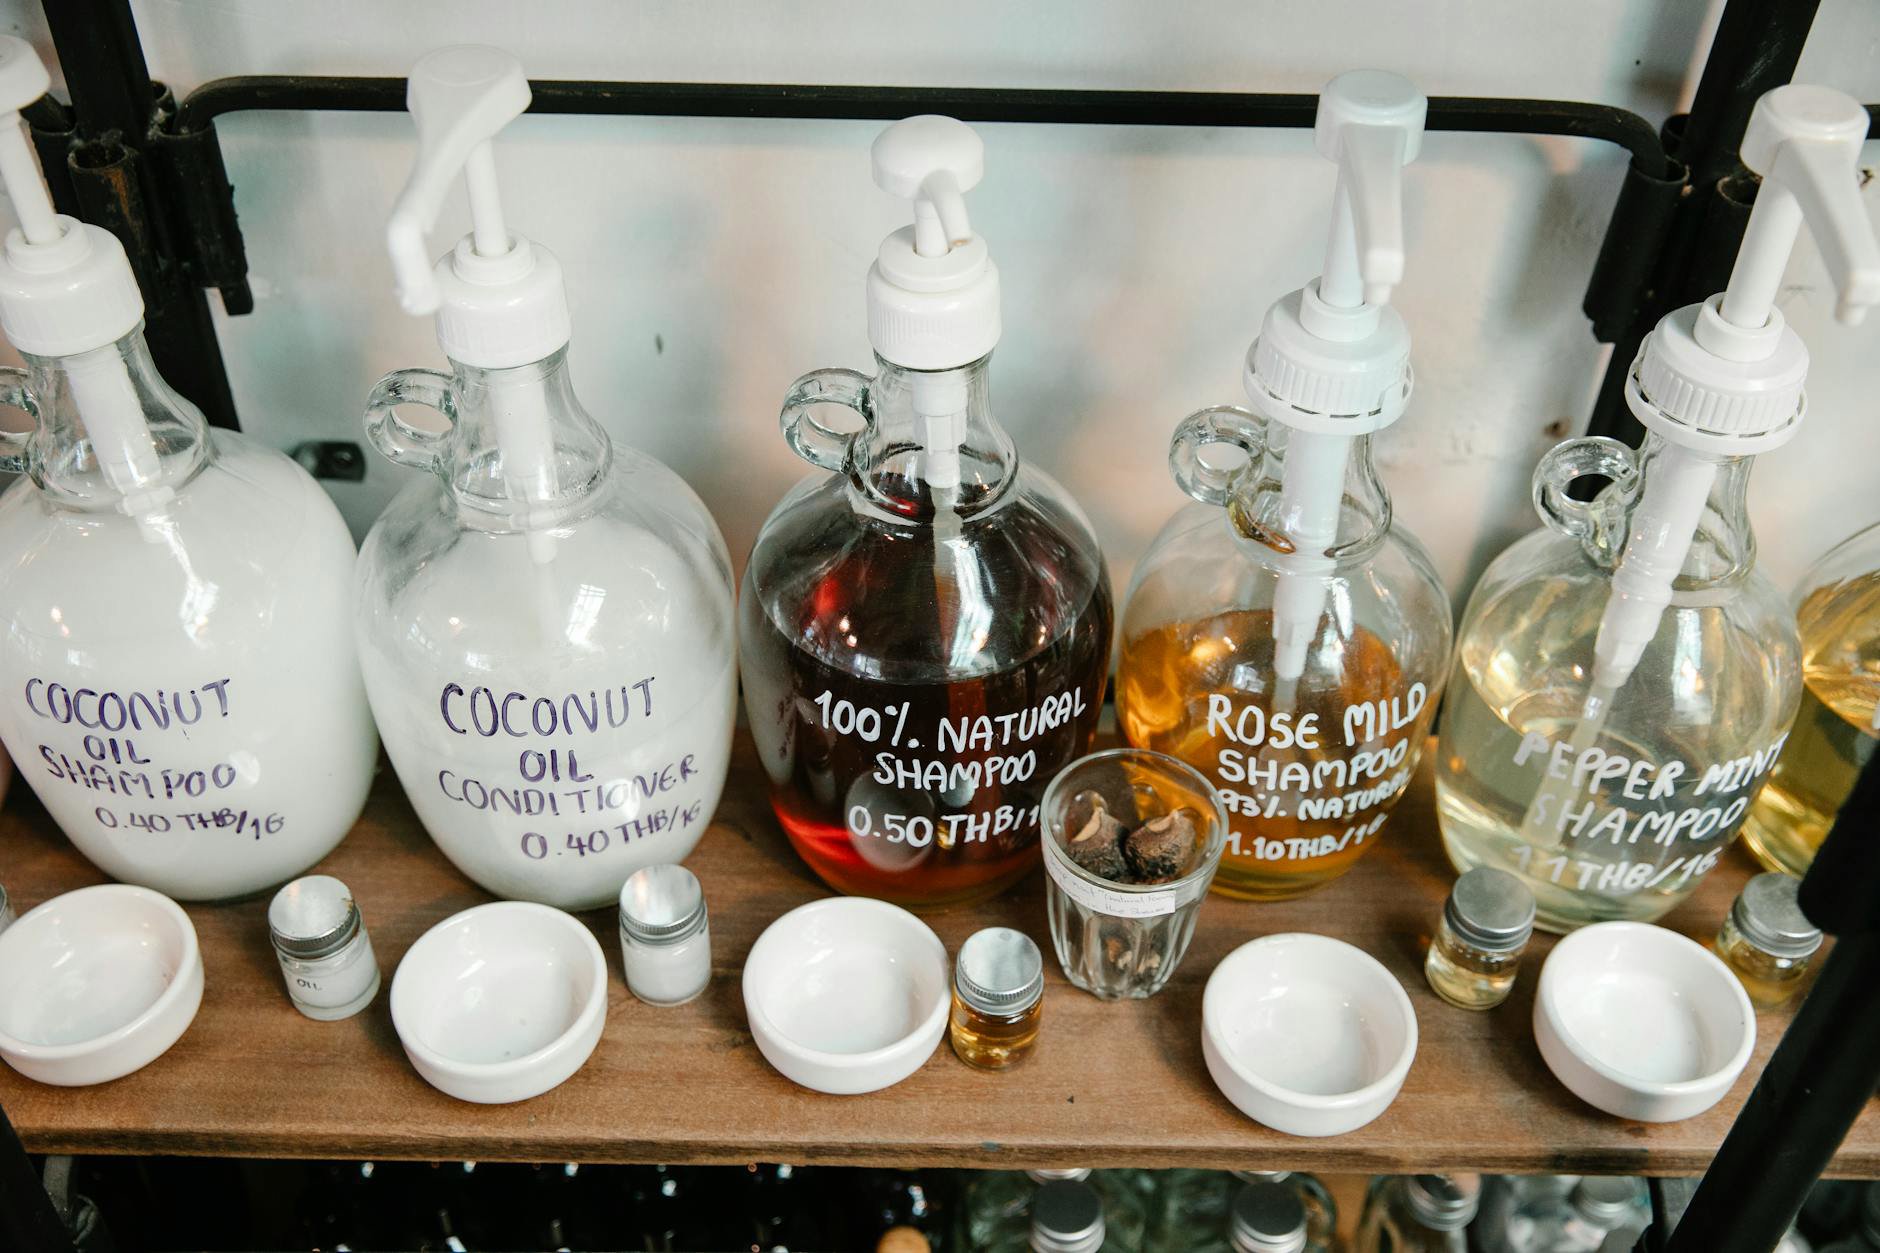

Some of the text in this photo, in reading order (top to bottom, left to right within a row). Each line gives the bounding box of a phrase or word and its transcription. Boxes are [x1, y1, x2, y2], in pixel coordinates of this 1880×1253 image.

[25, 678, 230, 731] COCONUT
[440, 676, 655, 737] COCONUT
[938, 686, 1087, 753] NATURAL
[1207, 682, 1426, 749] ROSE MILD
[38, 745, 236, 799] SHAMPOO
[83, 735, 150, 764] OIL
[519, 749, 594, 782] OIL
[873, 750, 1036, 793] SHAMPOO
[1217, 738, 1408, 792] SHAMPOO
[1512, 731, 1789, 801] PEPPER MINT
[438, 754, 698, 816] CONDITIONER
[95, 807, 284, 840] 0.40 THB/1G
[520, 829, 610, 859] 0.40
[848, 804, 1040, 848] 0.50 THB/1
[1533, 796, 1748, 847] SHAMPOO
